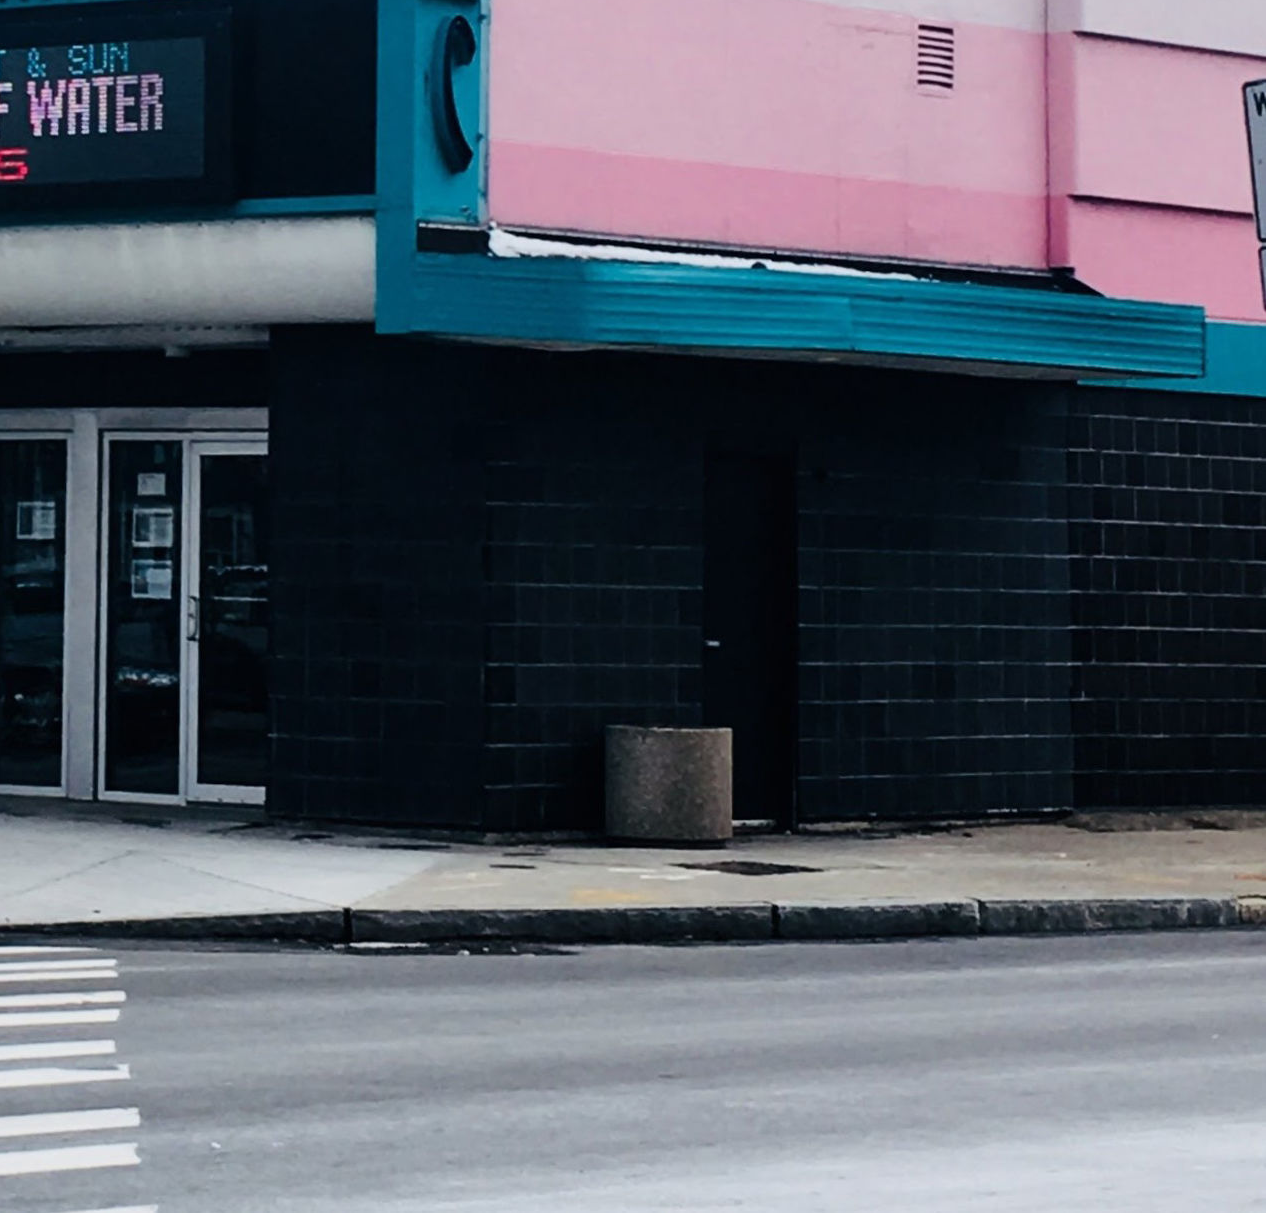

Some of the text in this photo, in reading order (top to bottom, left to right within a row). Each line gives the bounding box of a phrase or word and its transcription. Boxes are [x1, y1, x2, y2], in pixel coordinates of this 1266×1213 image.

[27, 48, 46, 78] &
[68, 42, 129, 74] SUN
[27, 73, 163, 137] WATER
